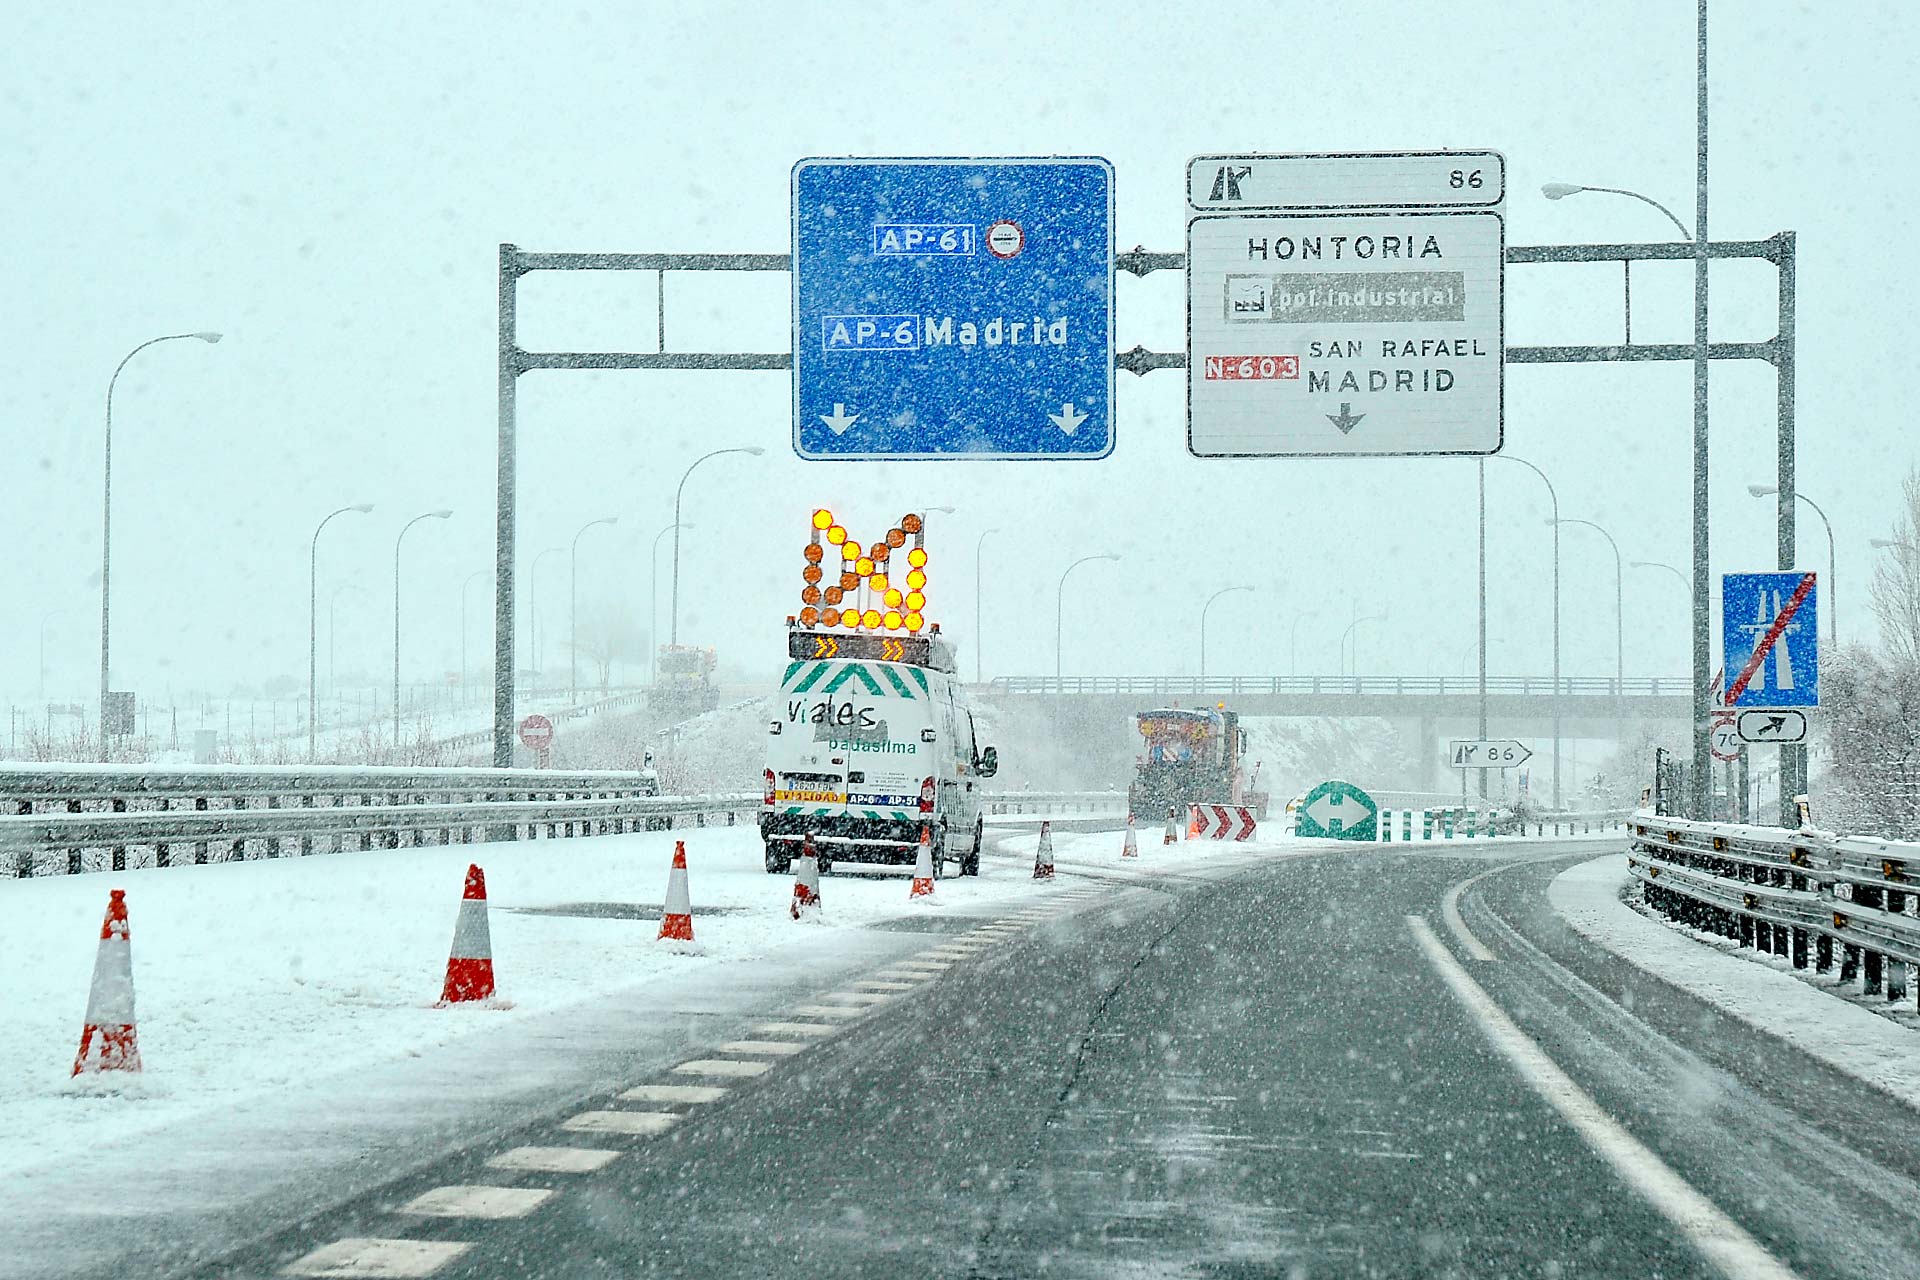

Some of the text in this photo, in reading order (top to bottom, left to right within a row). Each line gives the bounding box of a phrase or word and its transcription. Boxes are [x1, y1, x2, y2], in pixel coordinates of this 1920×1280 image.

[1449, 169, 1484, 189] 86
[880, 229, 971, 252] AP-61
[1248, 235, 1443, 261] HONTORIA
[1328, 286, 1455, 307] industrial
[829, 316, 1068, 345] AP-6 Madrid
[1309, 338, 1487, 358] SAN RAFAEL
[1206, 357, 1298, 379] N-603
[1308, 369, 1455, 393] MADRID
[1488, 747, 1514, 761] 86
